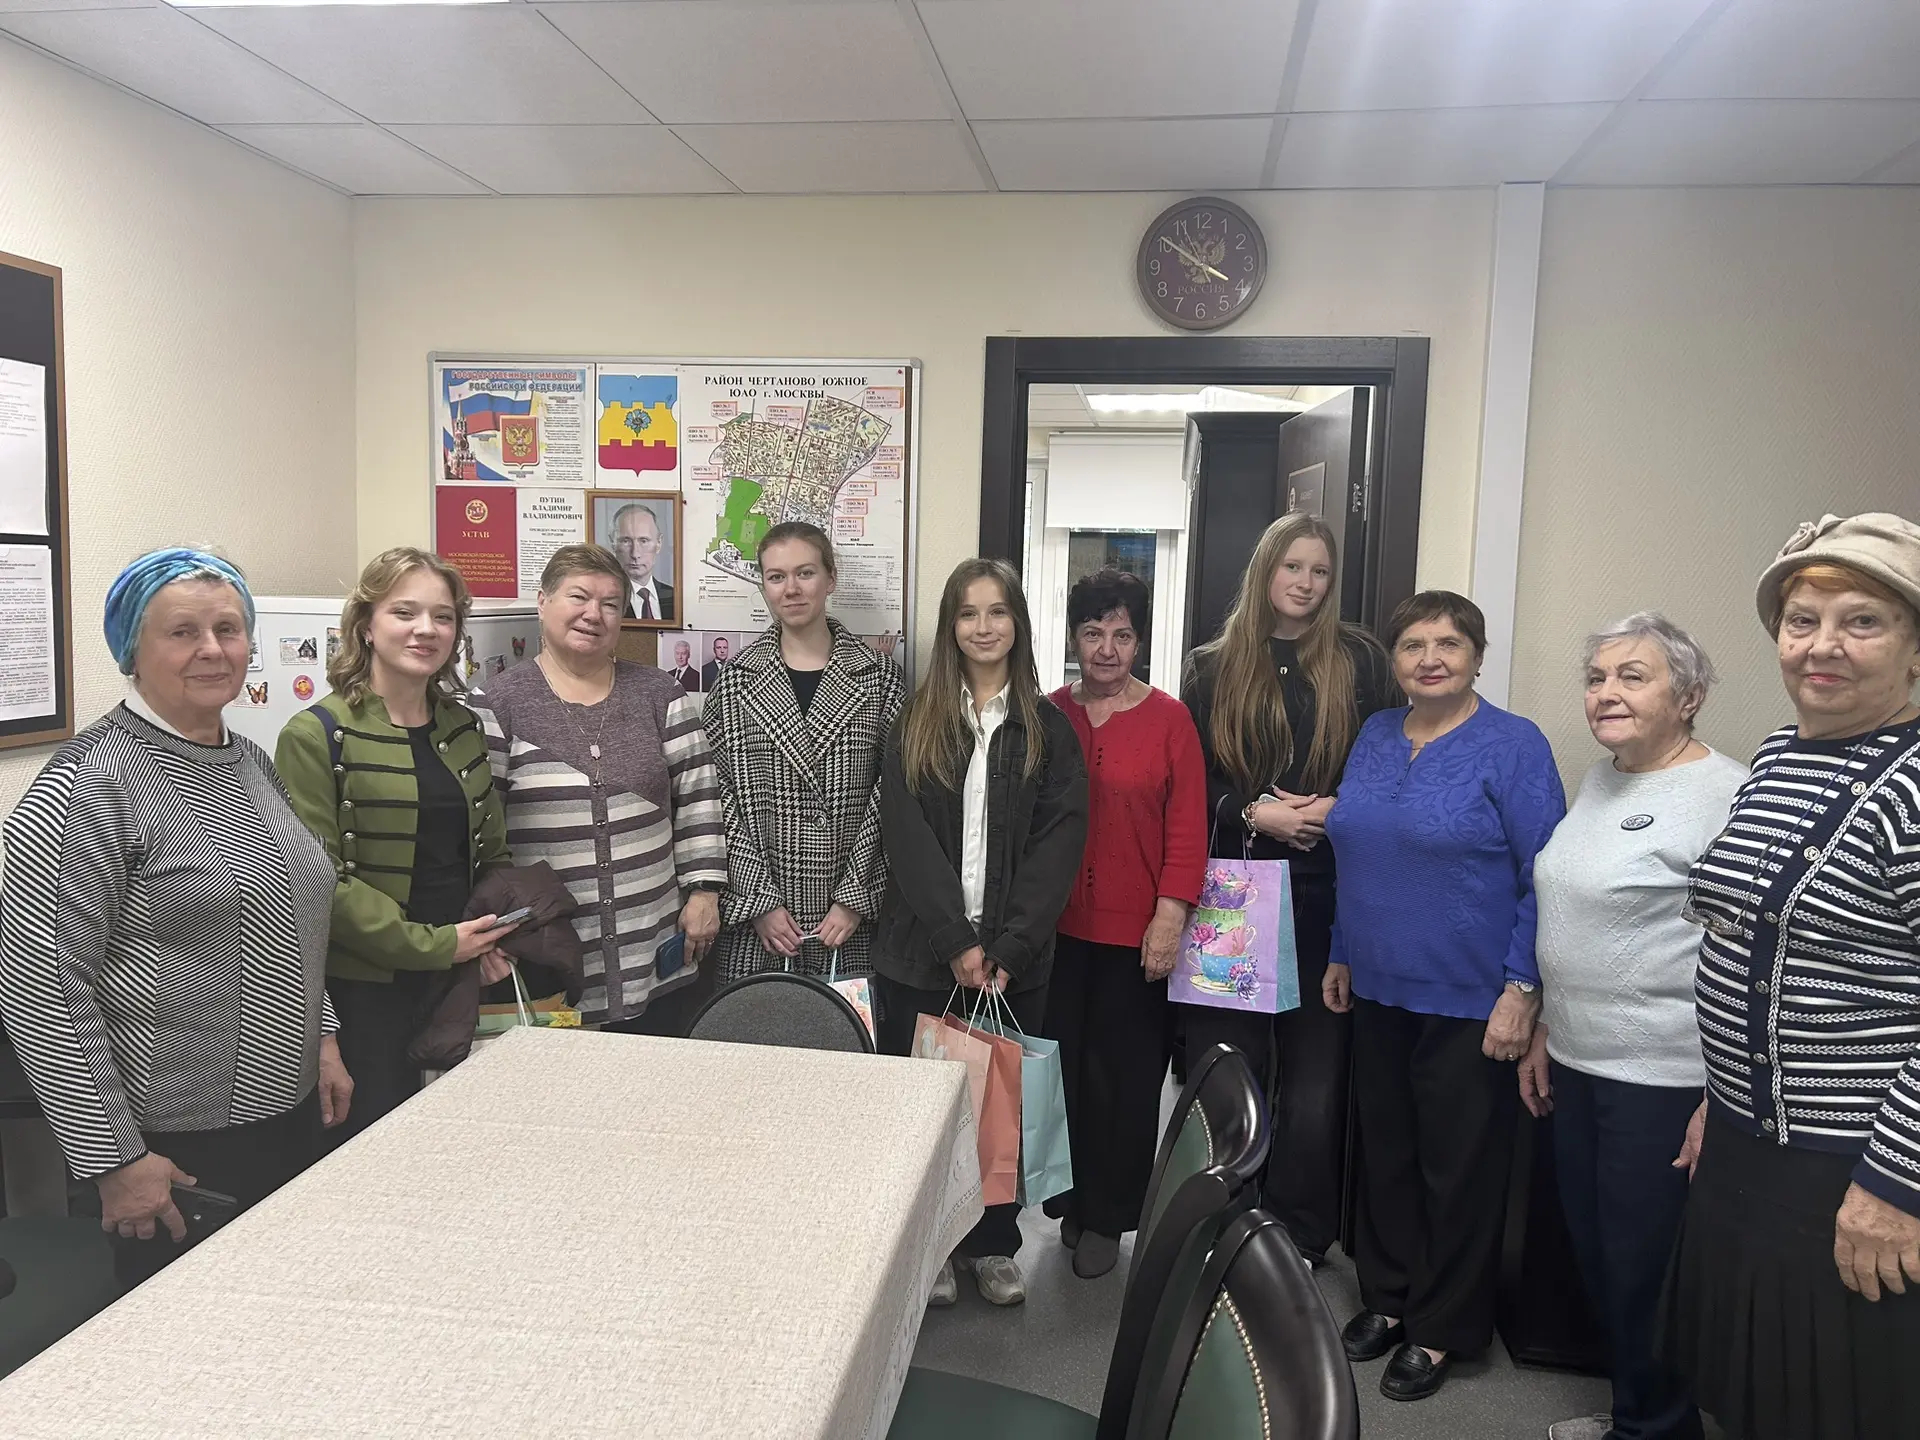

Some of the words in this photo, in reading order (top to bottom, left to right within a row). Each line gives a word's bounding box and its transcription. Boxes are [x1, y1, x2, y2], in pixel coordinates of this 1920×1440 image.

[1173, 220, 1187, 235] 11
[1193, 212, 1212, 228] 12
[1221, 218, 1227, 233] 1
[1158, 236, 1173, 253] 10
[1236, 234, 1246, 250] 2
[1150, 260, 1160, 276] 9
[1244, 256, 1254, 272] 3
[1157, 282, 1168, 297] 8
[1178, 284, 1226, 294] РОССИЯ
[1235, 279, 1245, 294] 4
[1174, 297, 1184, 312] 7
[1219, 295, 1230, 311] 5
[1195, 303, 1206, 319] 6
[452, 370, 532, 380] ГОСУДАРСТВЕННЫЕ
[534, 371, 577, 381] СИМВОЛЫ
[705, 374, 742, 385] РАЙОН
[749, 376, 815, 386] ЧЕРТАНОВО
[822, 377, 868, 386] ЮЖНОЕ
[469, 382, 526, 391] РОССИЙСКОЙ
[528, 382, 582, 393] ФЕДЕРАЦИИ
[730, 389, 756, 397] ЮАО
[774, 390, 824, 398] МОСКВЫ
